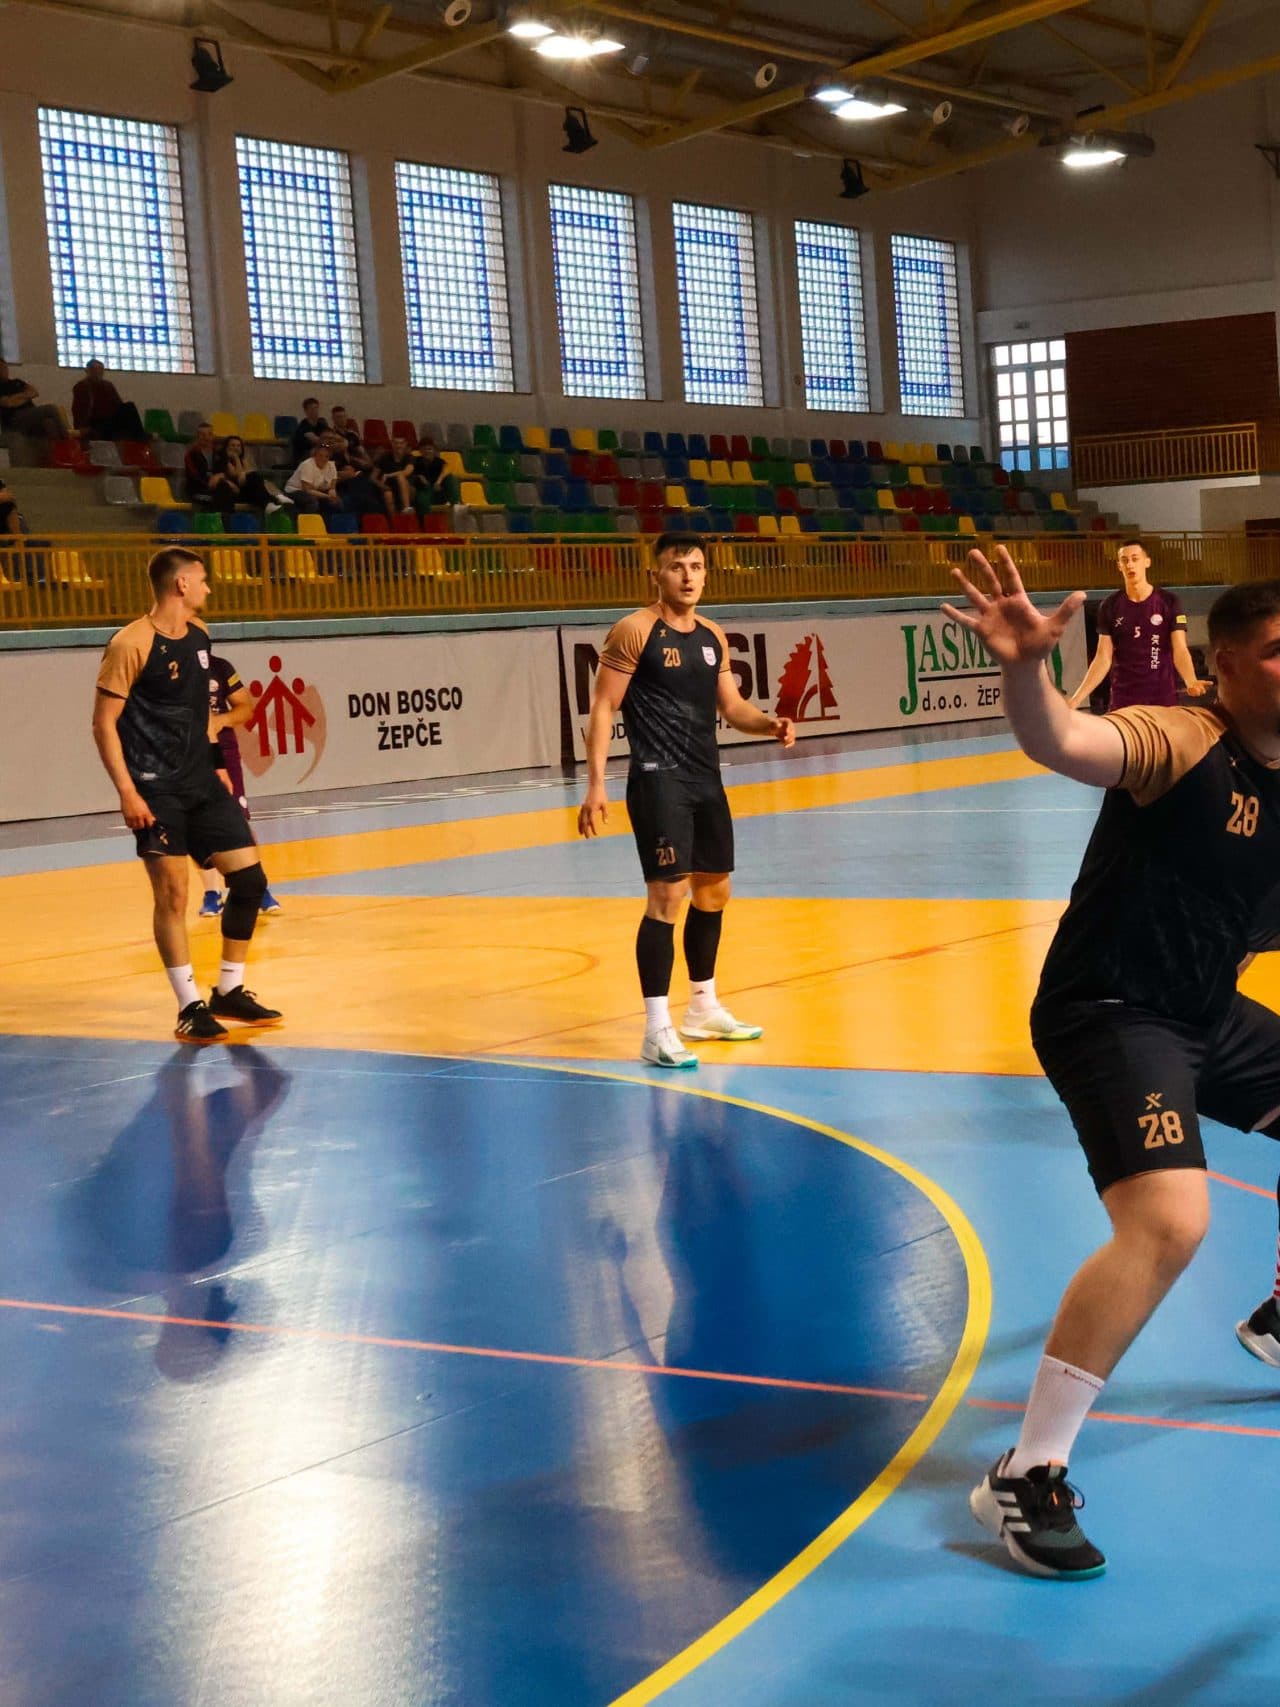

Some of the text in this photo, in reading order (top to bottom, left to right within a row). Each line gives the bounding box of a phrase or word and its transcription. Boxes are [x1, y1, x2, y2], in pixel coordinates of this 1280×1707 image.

[1133, 626, 1141, 638] 5
[662, 647, 682, 667] 20
[348, 686, 463, 719] DON BOSCO
[922, 685, 1000, 711] d.o.o. ŽEP
[377, 717, 442, 751] ŽEPČE
[1225, 790, 1260, 838] 28
[655, 846, 677, 866] 20
[1137, 1110, 1185, 1150] 28
